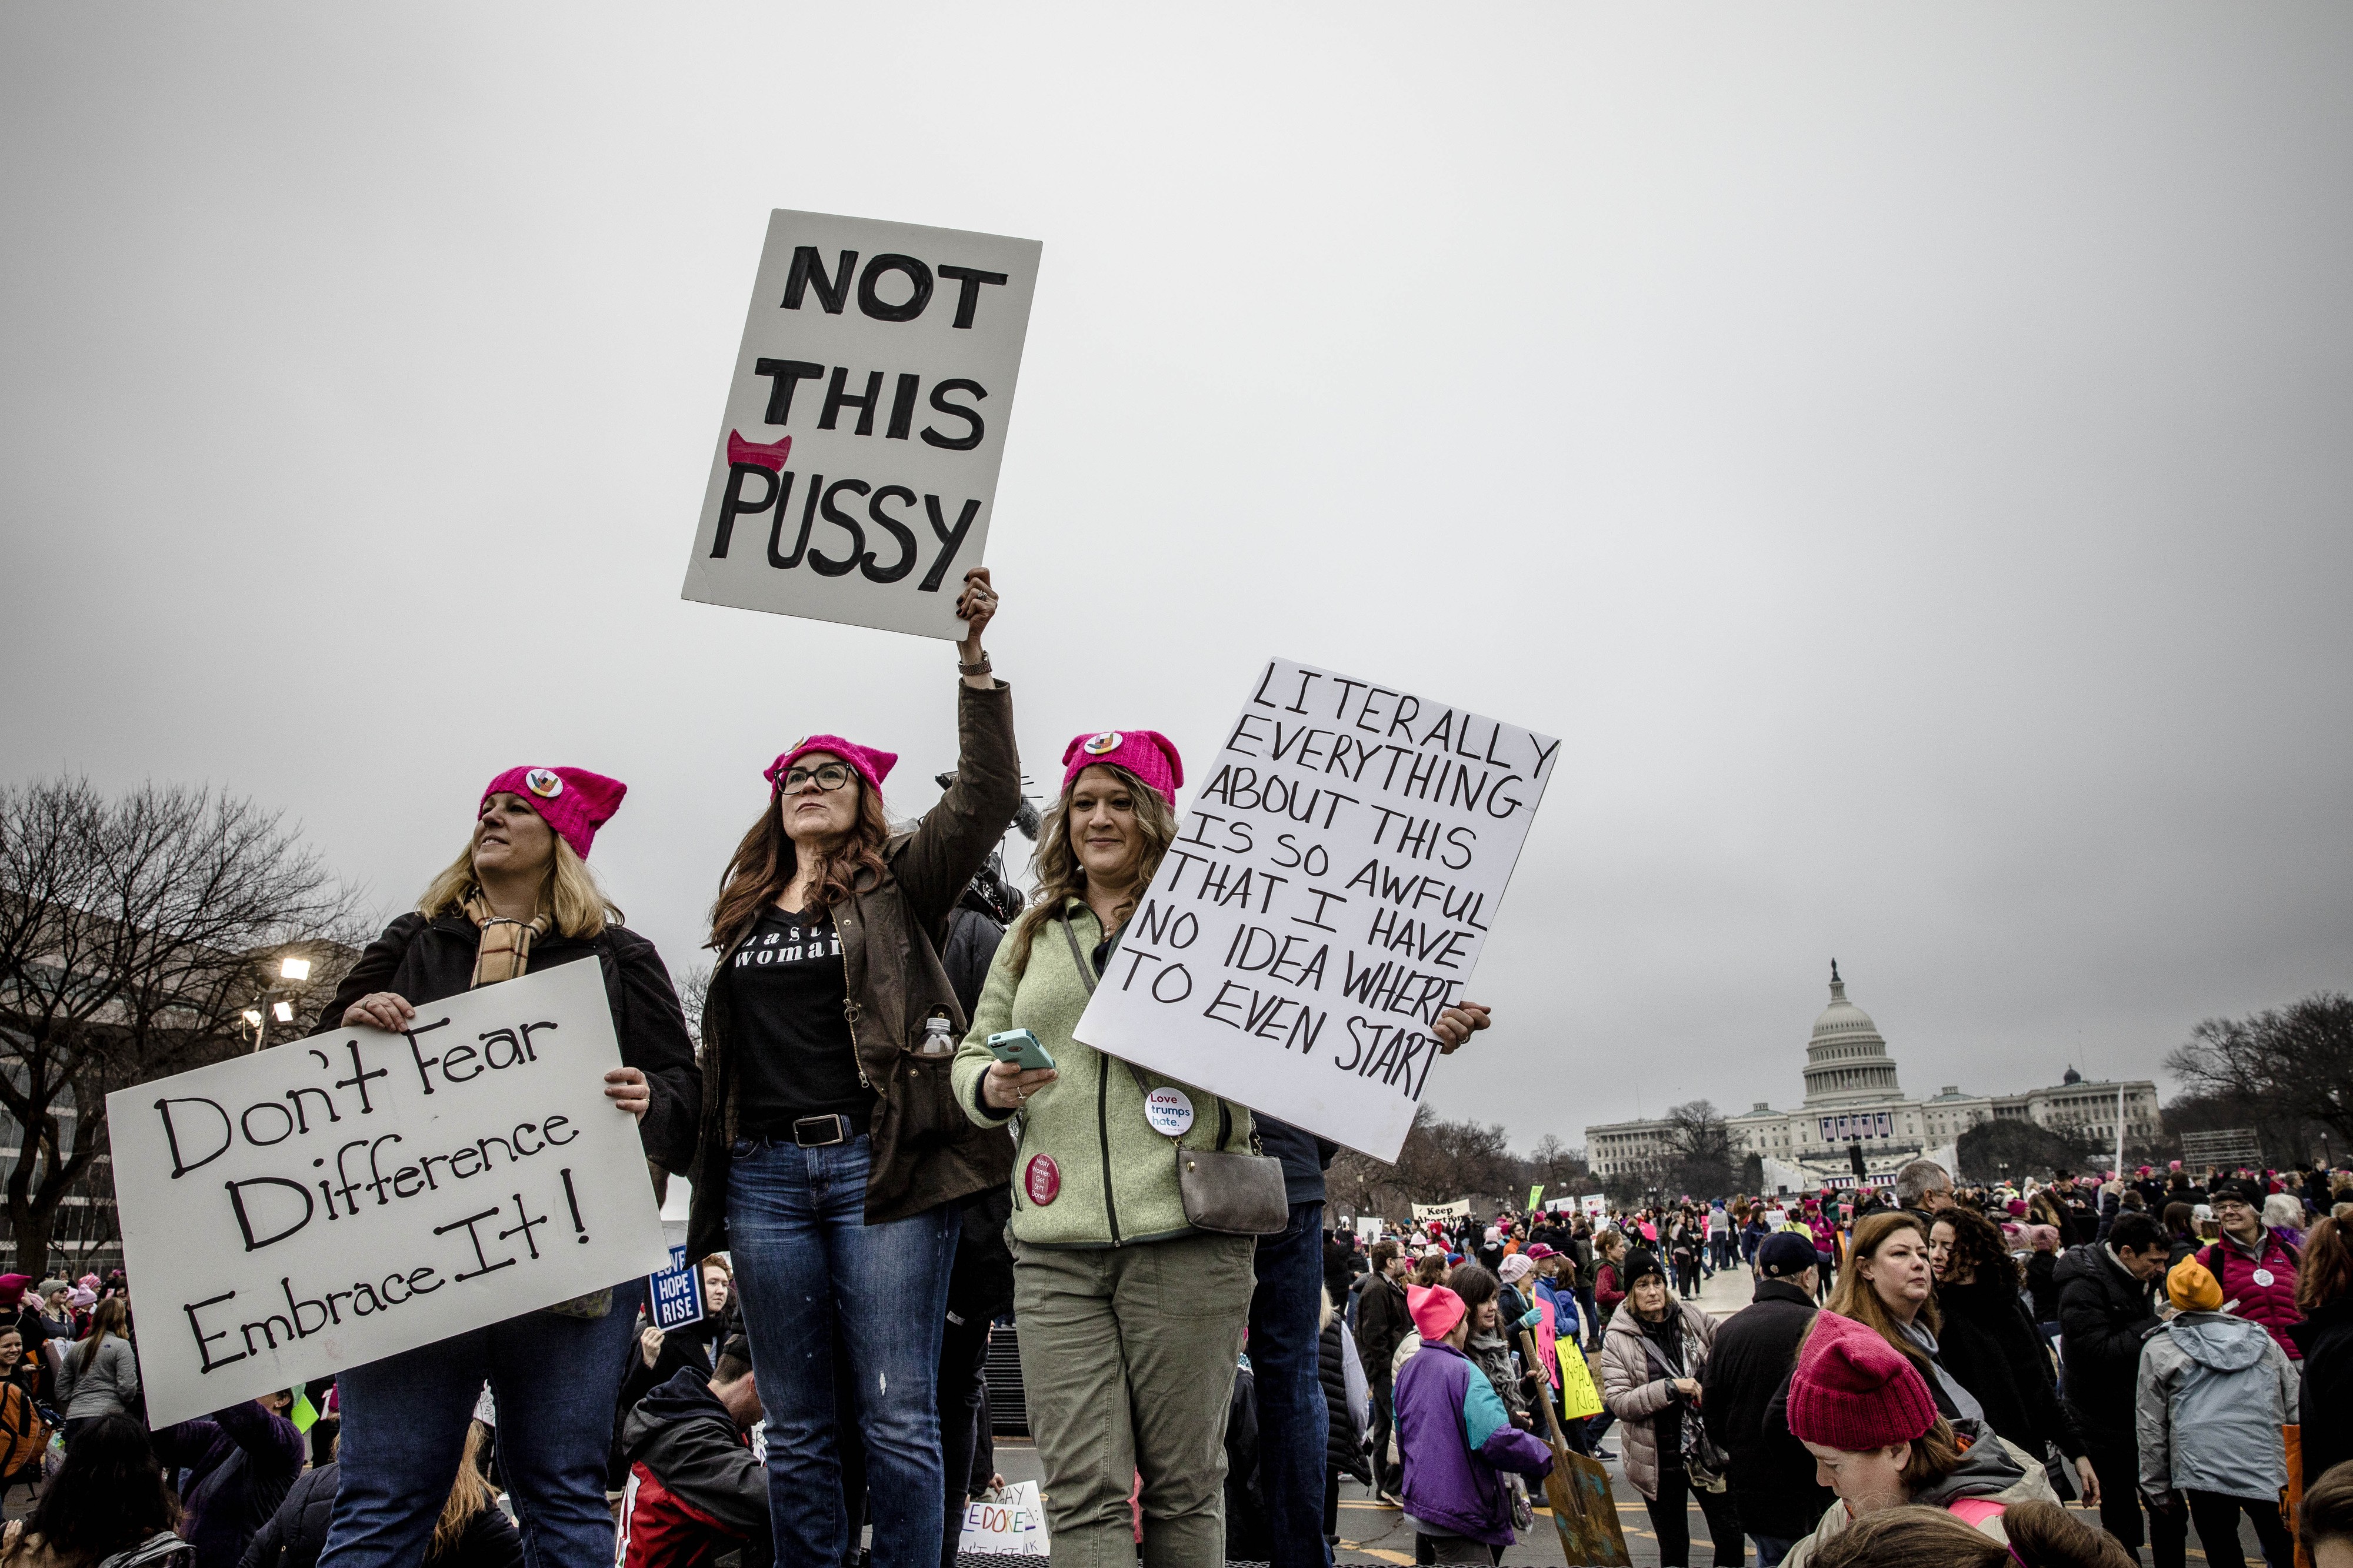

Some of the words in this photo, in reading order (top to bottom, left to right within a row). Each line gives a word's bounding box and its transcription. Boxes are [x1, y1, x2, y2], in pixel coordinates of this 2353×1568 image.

[780, 246, 1008, 328] NOT
[755, 358, 988, 451] THIS
[709, 462, 982, 592] PUSSY
[1225, 714, 1522, 819] EVERYTHING
[1253, 662, 1559, 779] LITERALLY
[1201, 765, 1359, 829] ABOUT
[1371, 805, 1476, 870] THIS
[1168, 849, 1287, 914] THAT
[1291, 888, 1347, 933] I
[1368, 910, 1475, 970] HAVE
[1176, 810, 1254, 854] IS
[1271, 834, 1329, 877] SO
[1345, 859, 1488, 932] AWFUL
[1135, 899, 1199, 949] NO
[1224, 923, 1326, 992] IDEA
[1343, 950, 1464, 1027] WHERE
[1121, 947, 1192, 1004] TO
[1203, 980, 1328, 1055] EVEN
[1334, 1016, 1444, 1102] START
[154, 1040, 388, 1179] Don't
[401, 1017, 558, 1095] Fear
[1150, 1093, 1177, 1103] Love
[1151, 1105, 1190, 1117] trumps
[1152, 1116, 1179, 1126] hate.
[226, 1115, 579, 1252] Difference
[1032, 1166, 1050, 1177] Women
[1032, 1190, 1046, 1200] Done!
[1036, 1158, 1049, 1168] Nasty
[184, 1266, 445, 1374] Embrace
[659, 1273, 690, 1300] HOPE
[662, 1296, 693, 1323] RISE
[995, 1485, 1024, 1505] GAY
